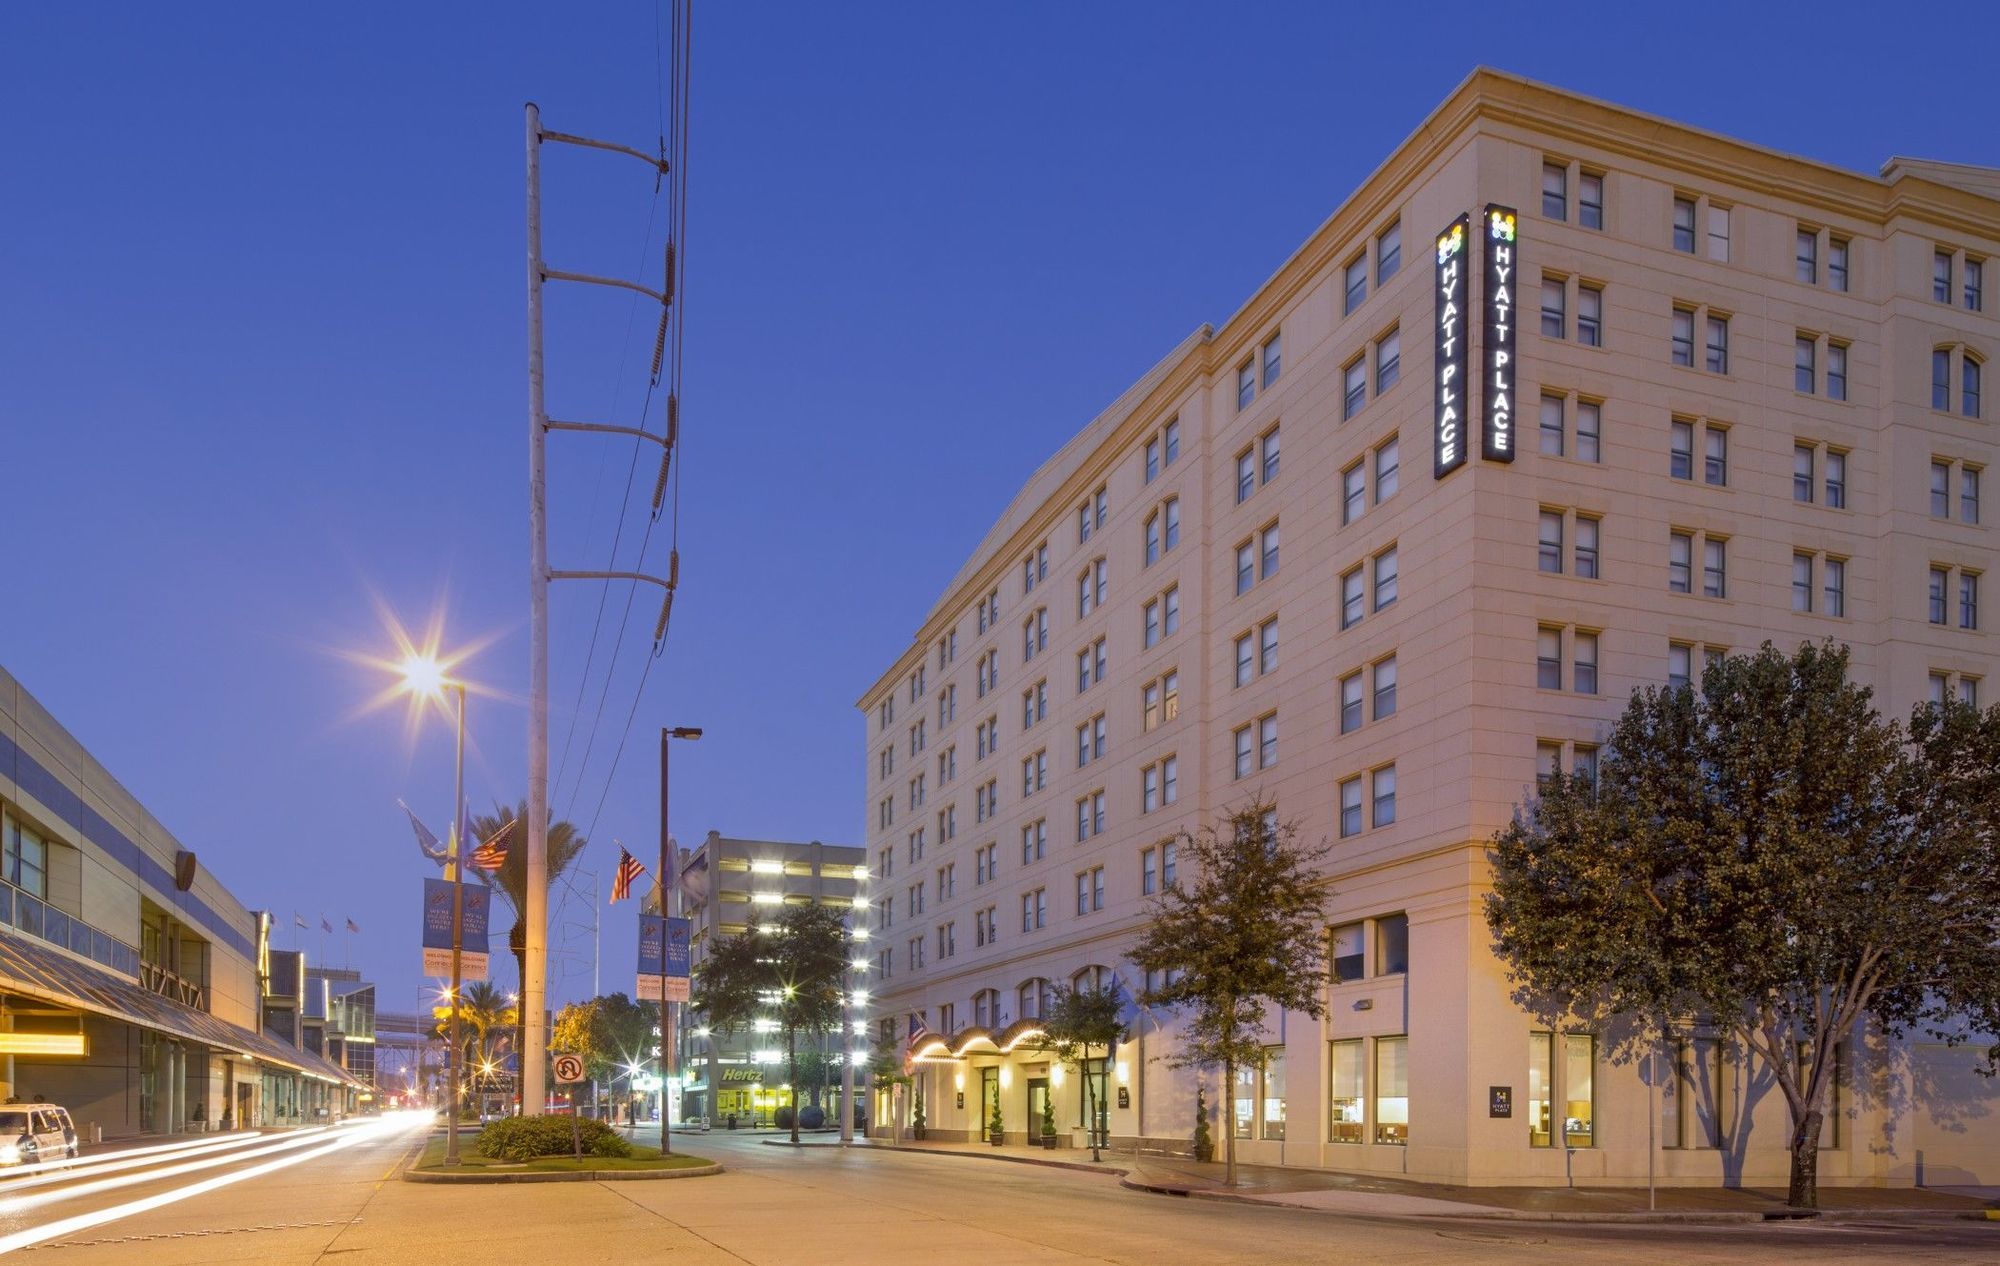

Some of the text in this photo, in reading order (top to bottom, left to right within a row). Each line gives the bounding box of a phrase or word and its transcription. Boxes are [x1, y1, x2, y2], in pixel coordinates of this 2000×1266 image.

[1441, 260, 1457, 464] HYATT PLACE
[1493, 245, 1510, 450] HYATT PLACE
[721, 1068, 763, 1081] Hertz
